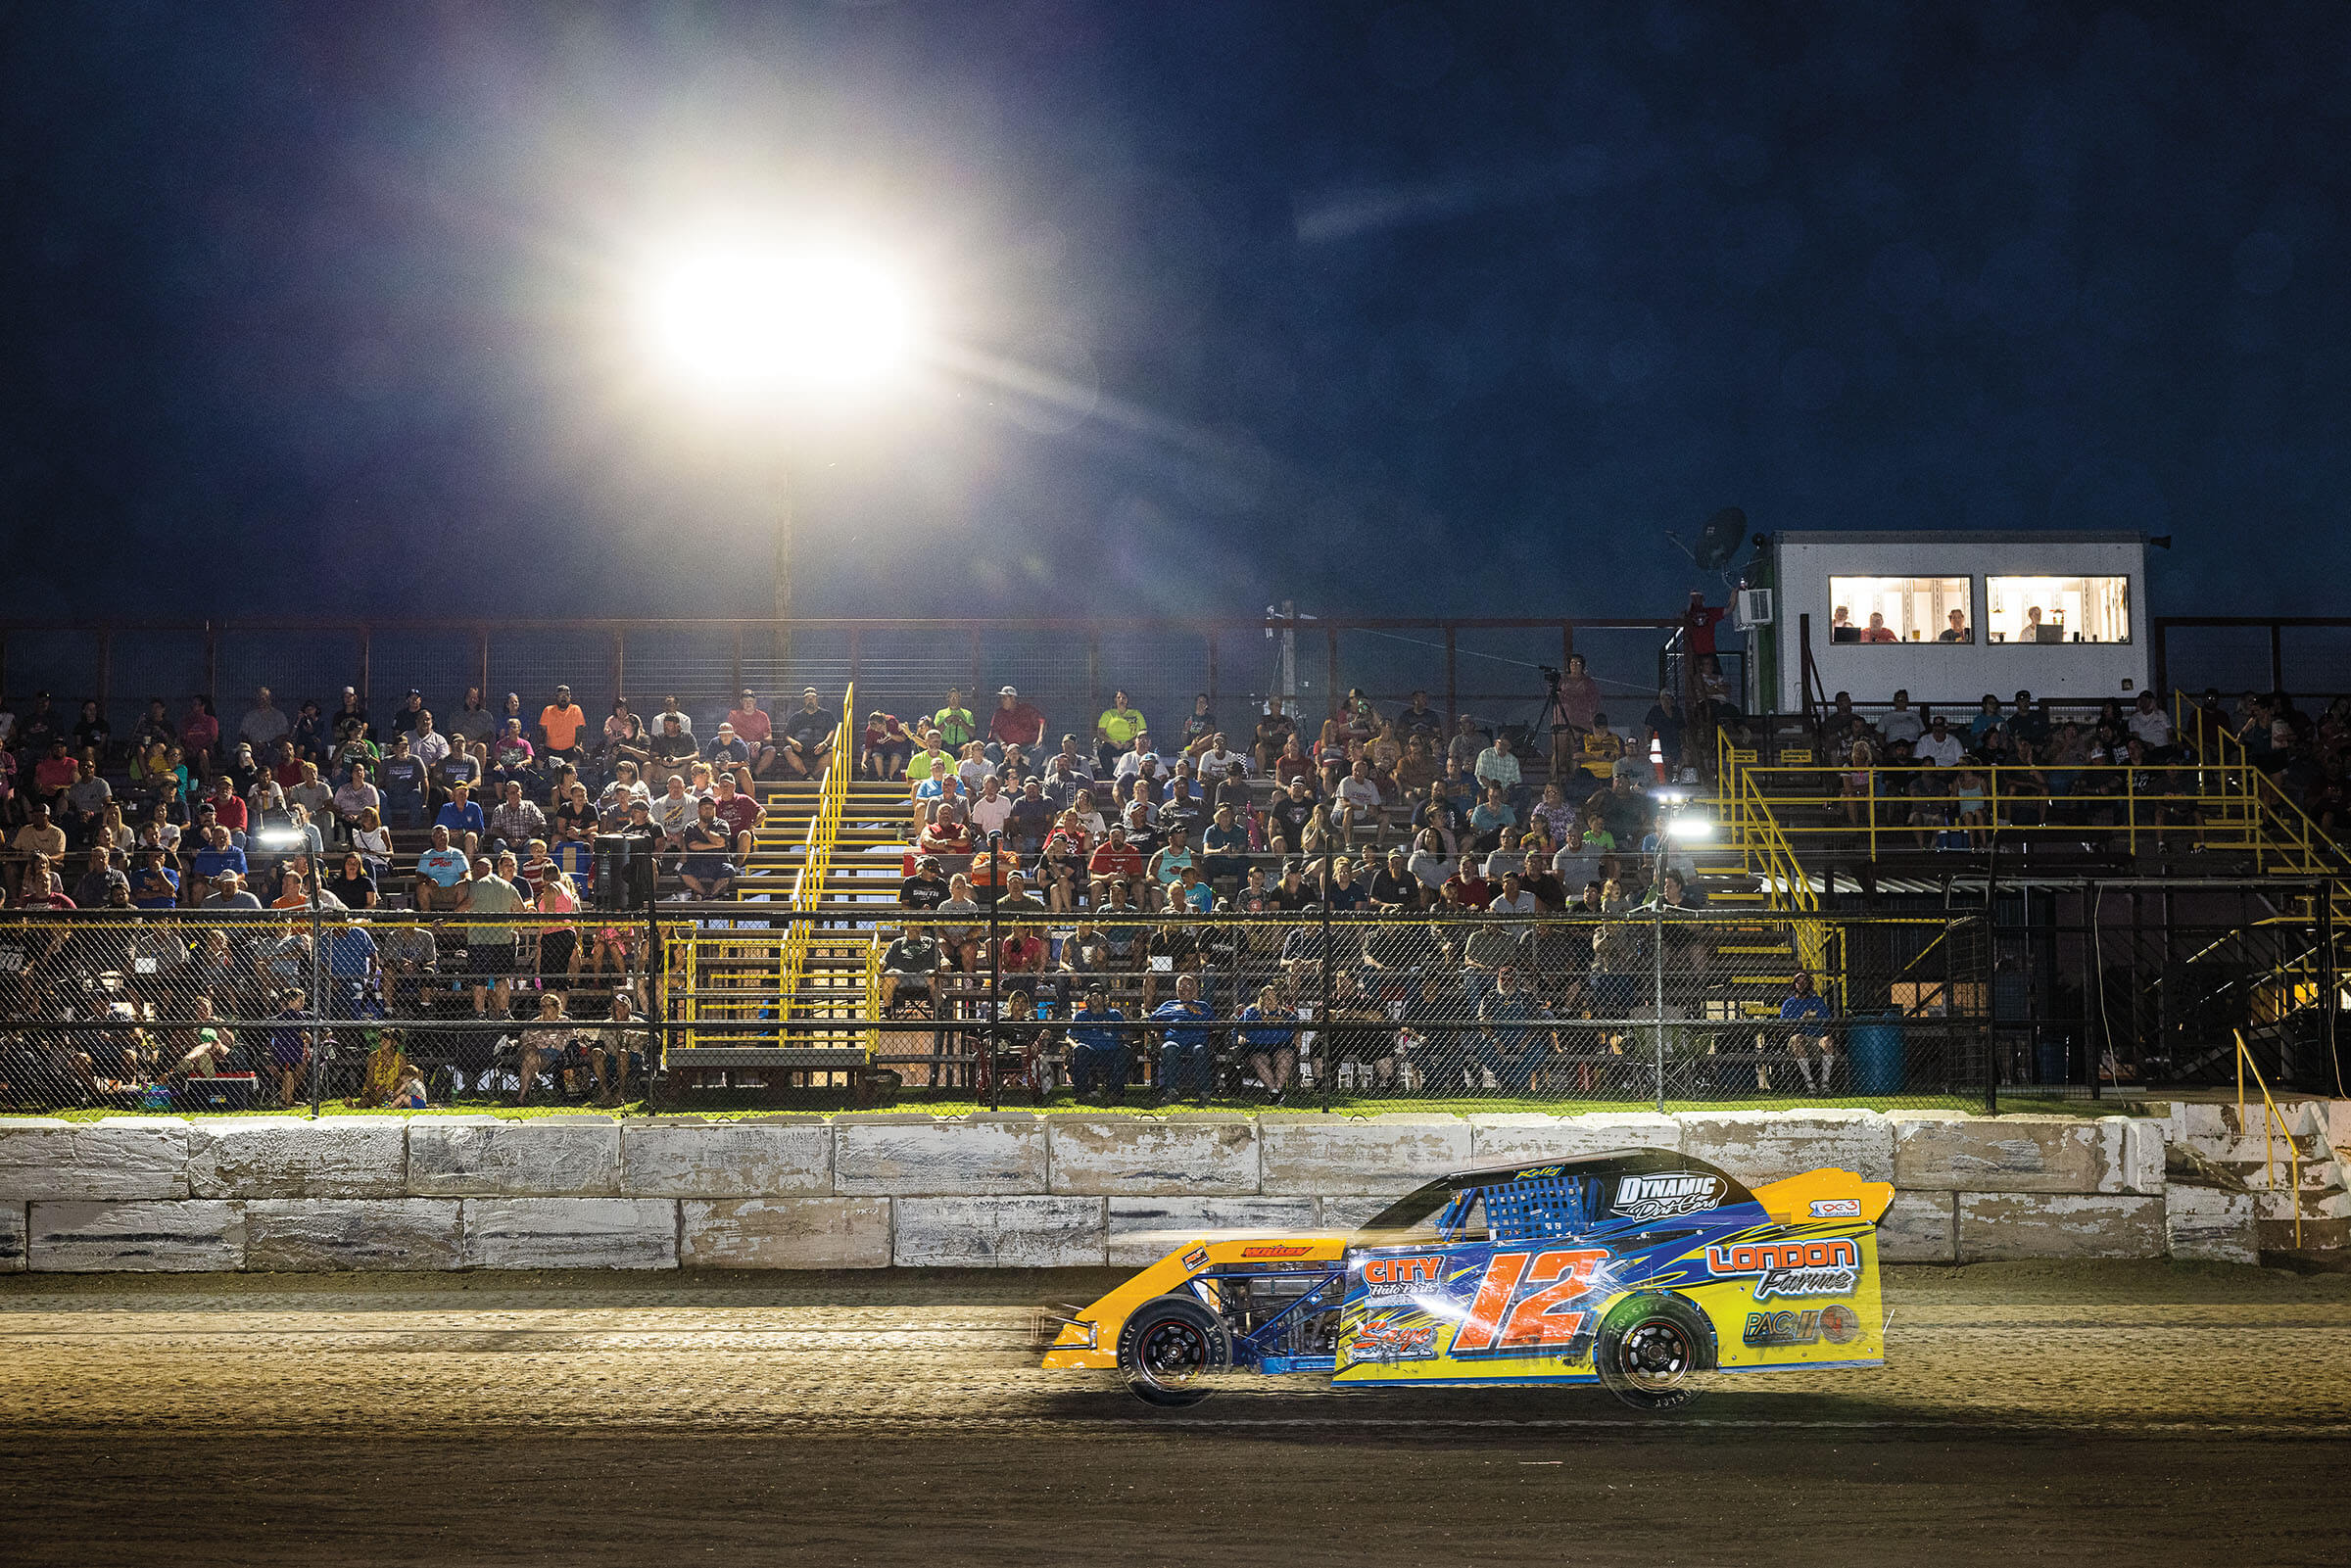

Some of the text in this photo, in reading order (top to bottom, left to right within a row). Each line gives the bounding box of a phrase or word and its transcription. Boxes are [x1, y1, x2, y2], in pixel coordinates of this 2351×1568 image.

[1627, 1193, 1717, 1220] Dirt Cars
[1365, 1258, 1440, 1283] CITY
[1757, 1268, 1852, 1298] Farms
[1371, 1281, 1436, 1296] Auto Parts
[1451, 1248, 1610, 1352] 12
[1745, 1310, 1795, 1336] PAC
